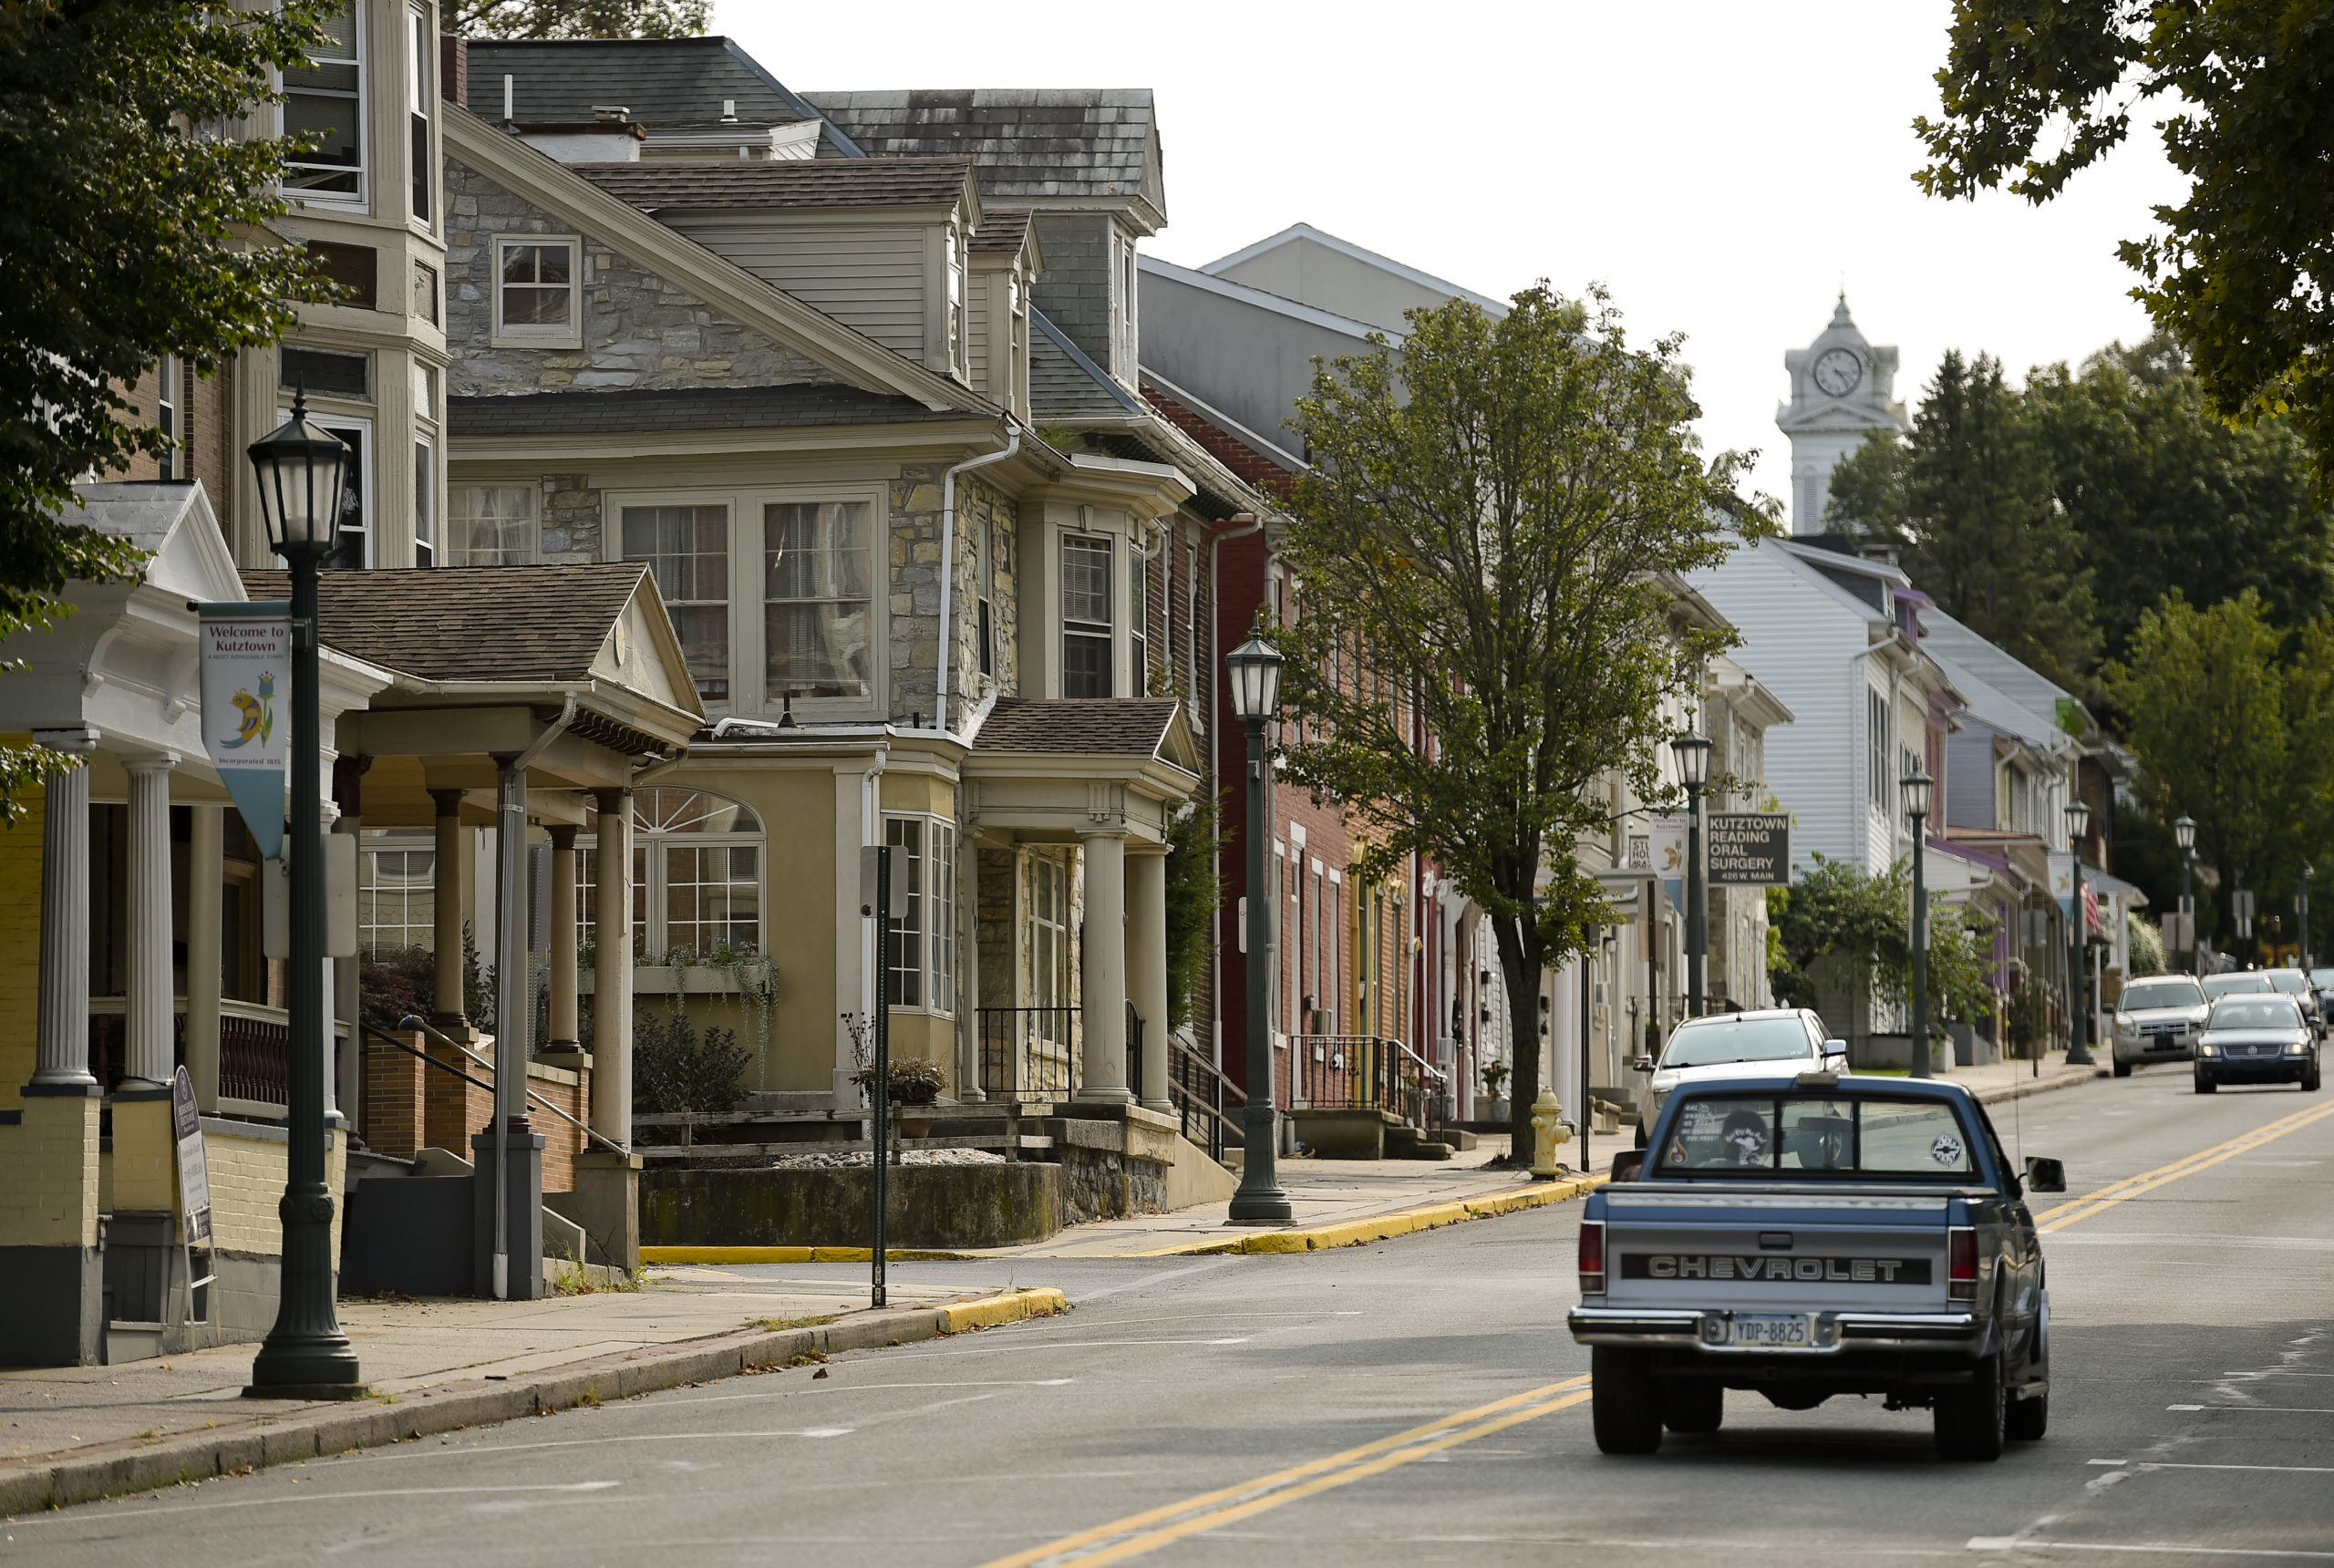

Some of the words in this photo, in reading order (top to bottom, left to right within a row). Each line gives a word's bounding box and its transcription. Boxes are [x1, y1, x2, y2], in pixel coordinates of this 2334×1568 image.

[209, 625, 266, 637] Welcome
[271, 626, 284, 637] to
[216, 640, 276, 652] Kutztown
[1709, 817, 1787, 830] KUTZTOWN
[1709, 830, 1771, 843] READING
[1709, 843, 1749, 857] ORAL
[1709, 857, 1774, 870] SURGERY
[1750, 872, 1775, 881] MAIN
[1647, 1254, 1904, 1282] CHEVROLET
